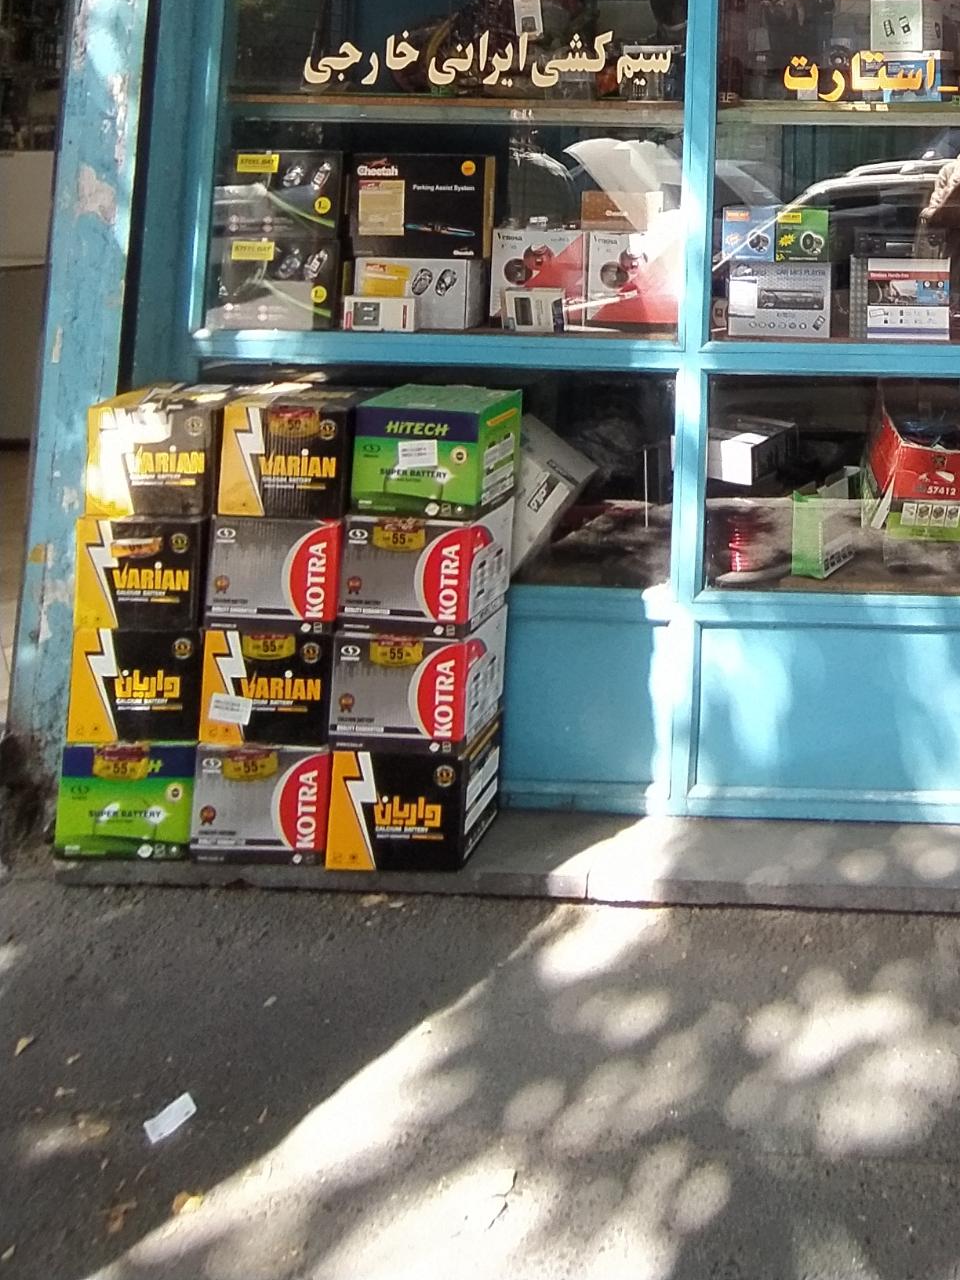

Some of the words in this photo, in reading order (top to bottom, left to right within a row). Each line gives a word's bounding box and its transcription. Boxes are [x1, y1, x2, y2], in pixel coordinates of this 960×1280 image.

[304, 29, 420, 85] خارجی
[428, 31, 528, 86] ایرانی
[531, 30, 613, 87] کشی
[616, 45, 672, 84] سیم
[783, 50, 937, 101] استارت
[357, 164, 399, 177] Cheetah
[412, 184, 435, 192] Parking
[454, 184, 475, 192] System
[380, 467, 409, 477] SUPER
[410, 469, 447, 480] BATTERY
[391, 533, 406, 544] 55
[305, 541, 328, 618] KOTRA
[438, 543, 461, 621] KOTRA
[262, 640, 277, 652] 55
[389, 647, 404, 660] 55
[433, 659, 455, 738] KOTRA
[113, 763, 128, 774] 55
[243, 760, 258, 773] 55
[89, 809, 121, 818] SUPER
[121, 809, 161, 819] BATTERY
[295, 769, 319, 849] KOTRA
